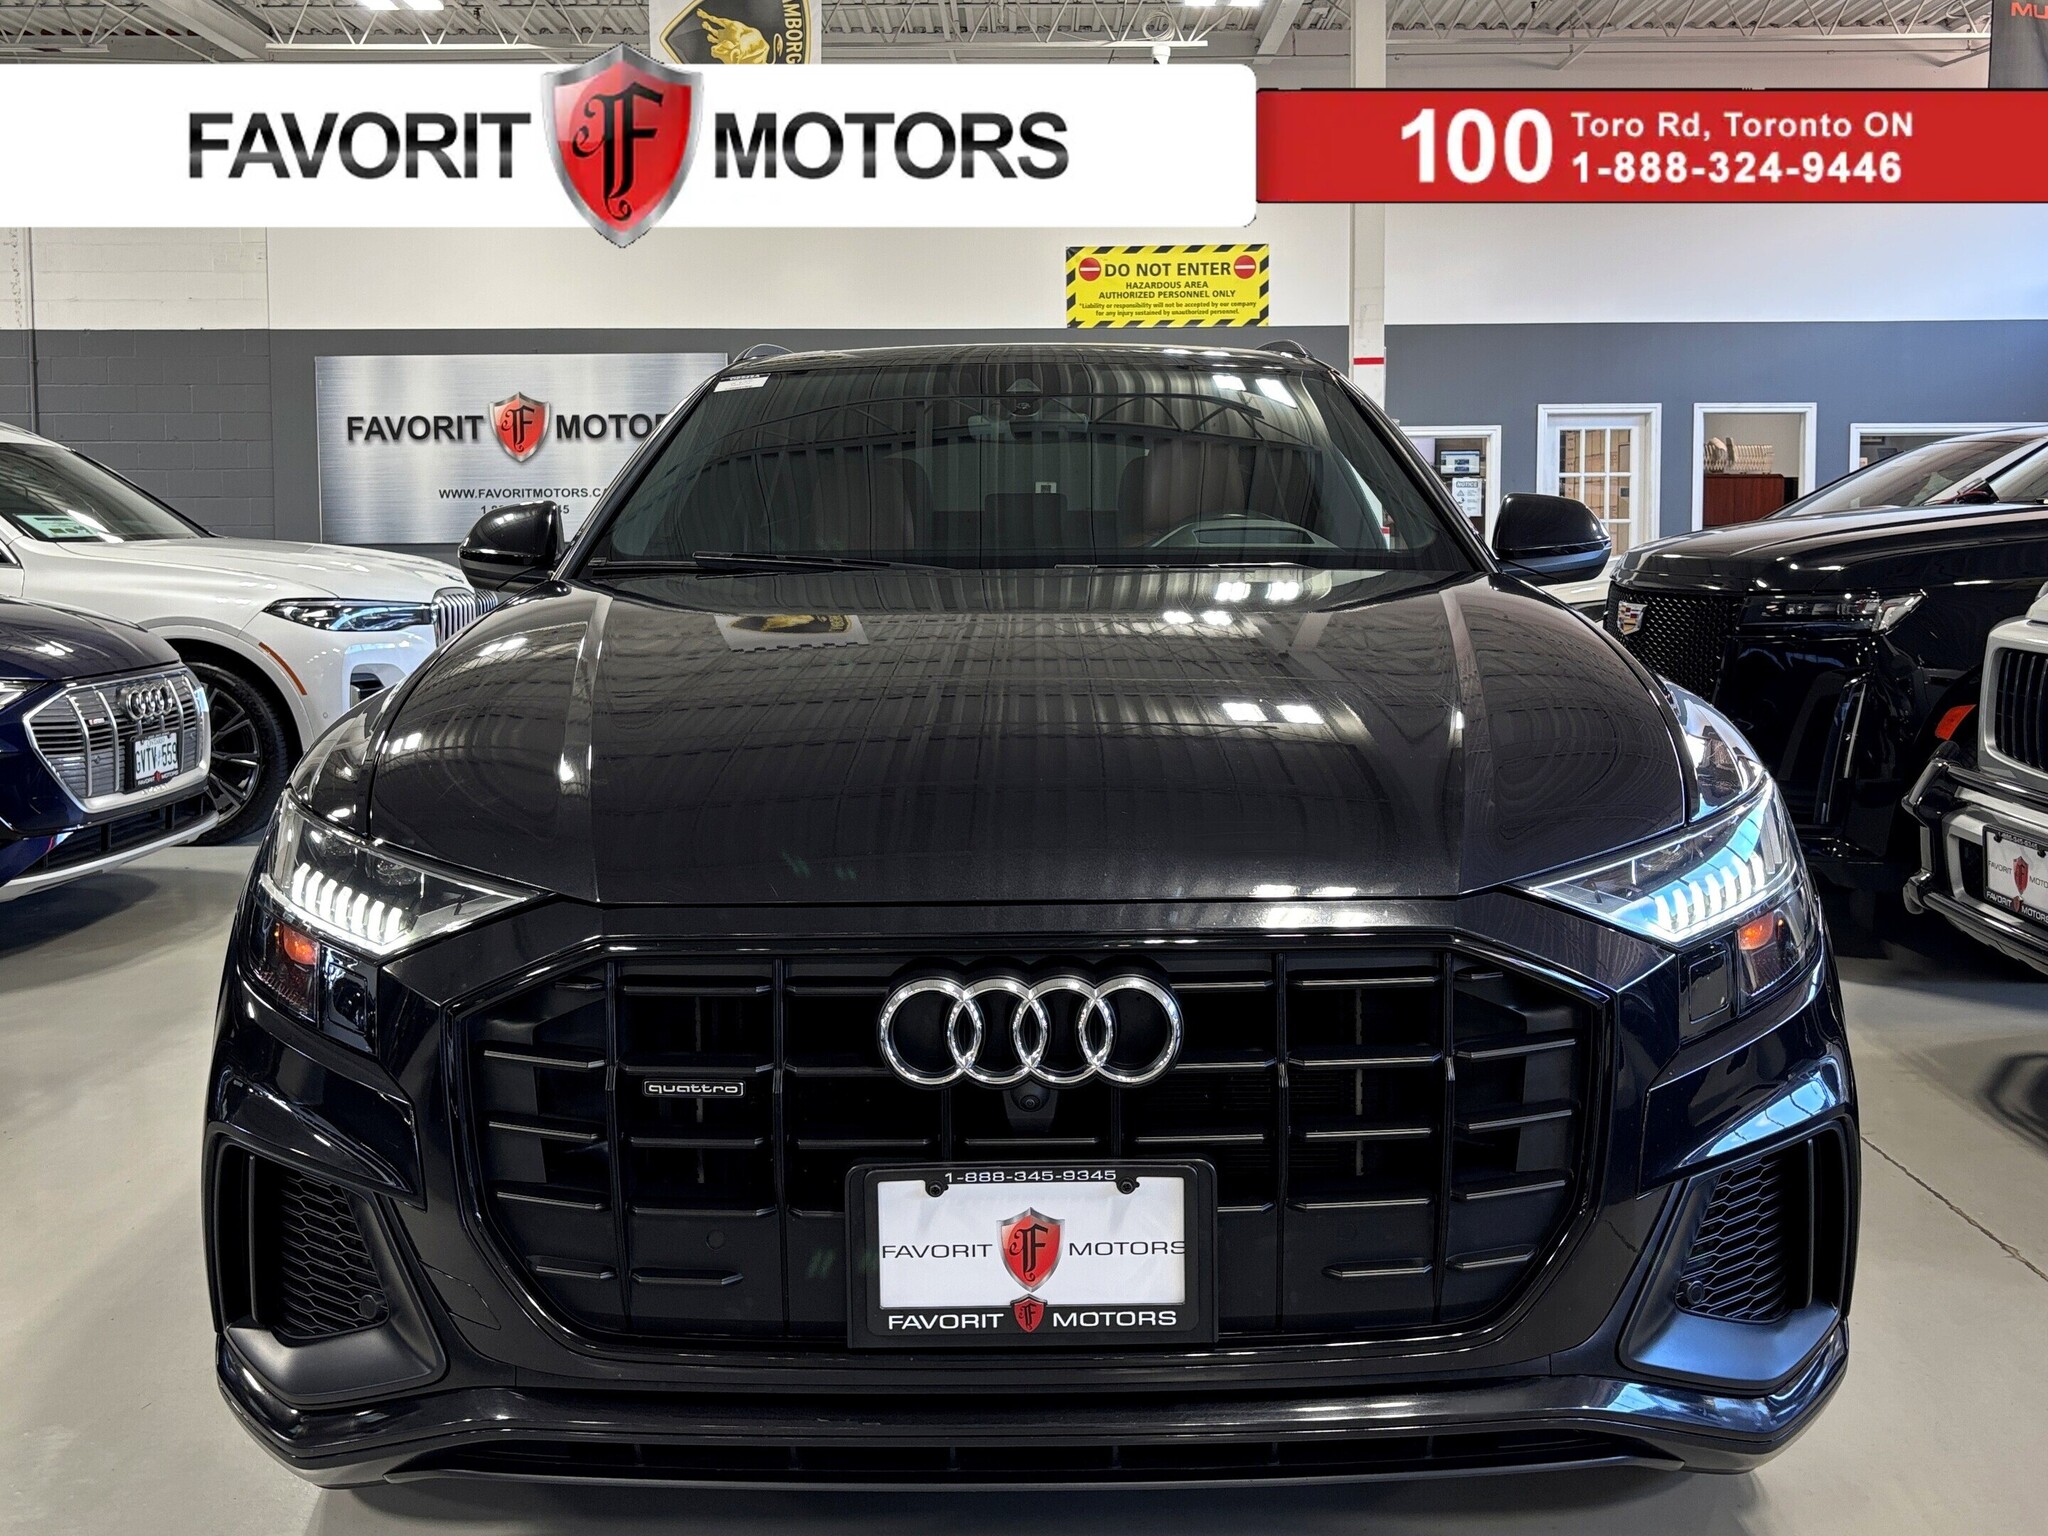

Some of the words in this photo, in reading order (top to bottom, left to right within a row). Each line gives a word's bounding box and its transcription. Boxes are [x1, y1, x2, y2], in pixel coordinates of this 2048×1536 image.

[782, 0, 803, 64] MBORG
[1105, 263, 1130, 277] DO
[1136, 263, 1172, 276] NOT
[1177, 262, 1231, 276] ENTER
[1125, 281, 1181, 290] HAZARDOUS
[1184, 281, 1209, 289] AREA
[1098, 291, 1155, 300] AUTHORIZED
[1157, 290, 1210, 299] PERSONNEL
[1212, 290, 1236, 298] ONLY
[347, 415, 484, 441] FAVORIT
[648, 1083, 738, 1094] quattro
[945, 1169, 1116, 1183] 1-888-345-9345
[882, 1243, 993, 1259] FAVORIT
[1069, 1240, 1185, 1257] MOTORS
[888, 1313, 1004, 1330] FAVORIT
[1053, 1310, 1177, 1328] MOTORS
